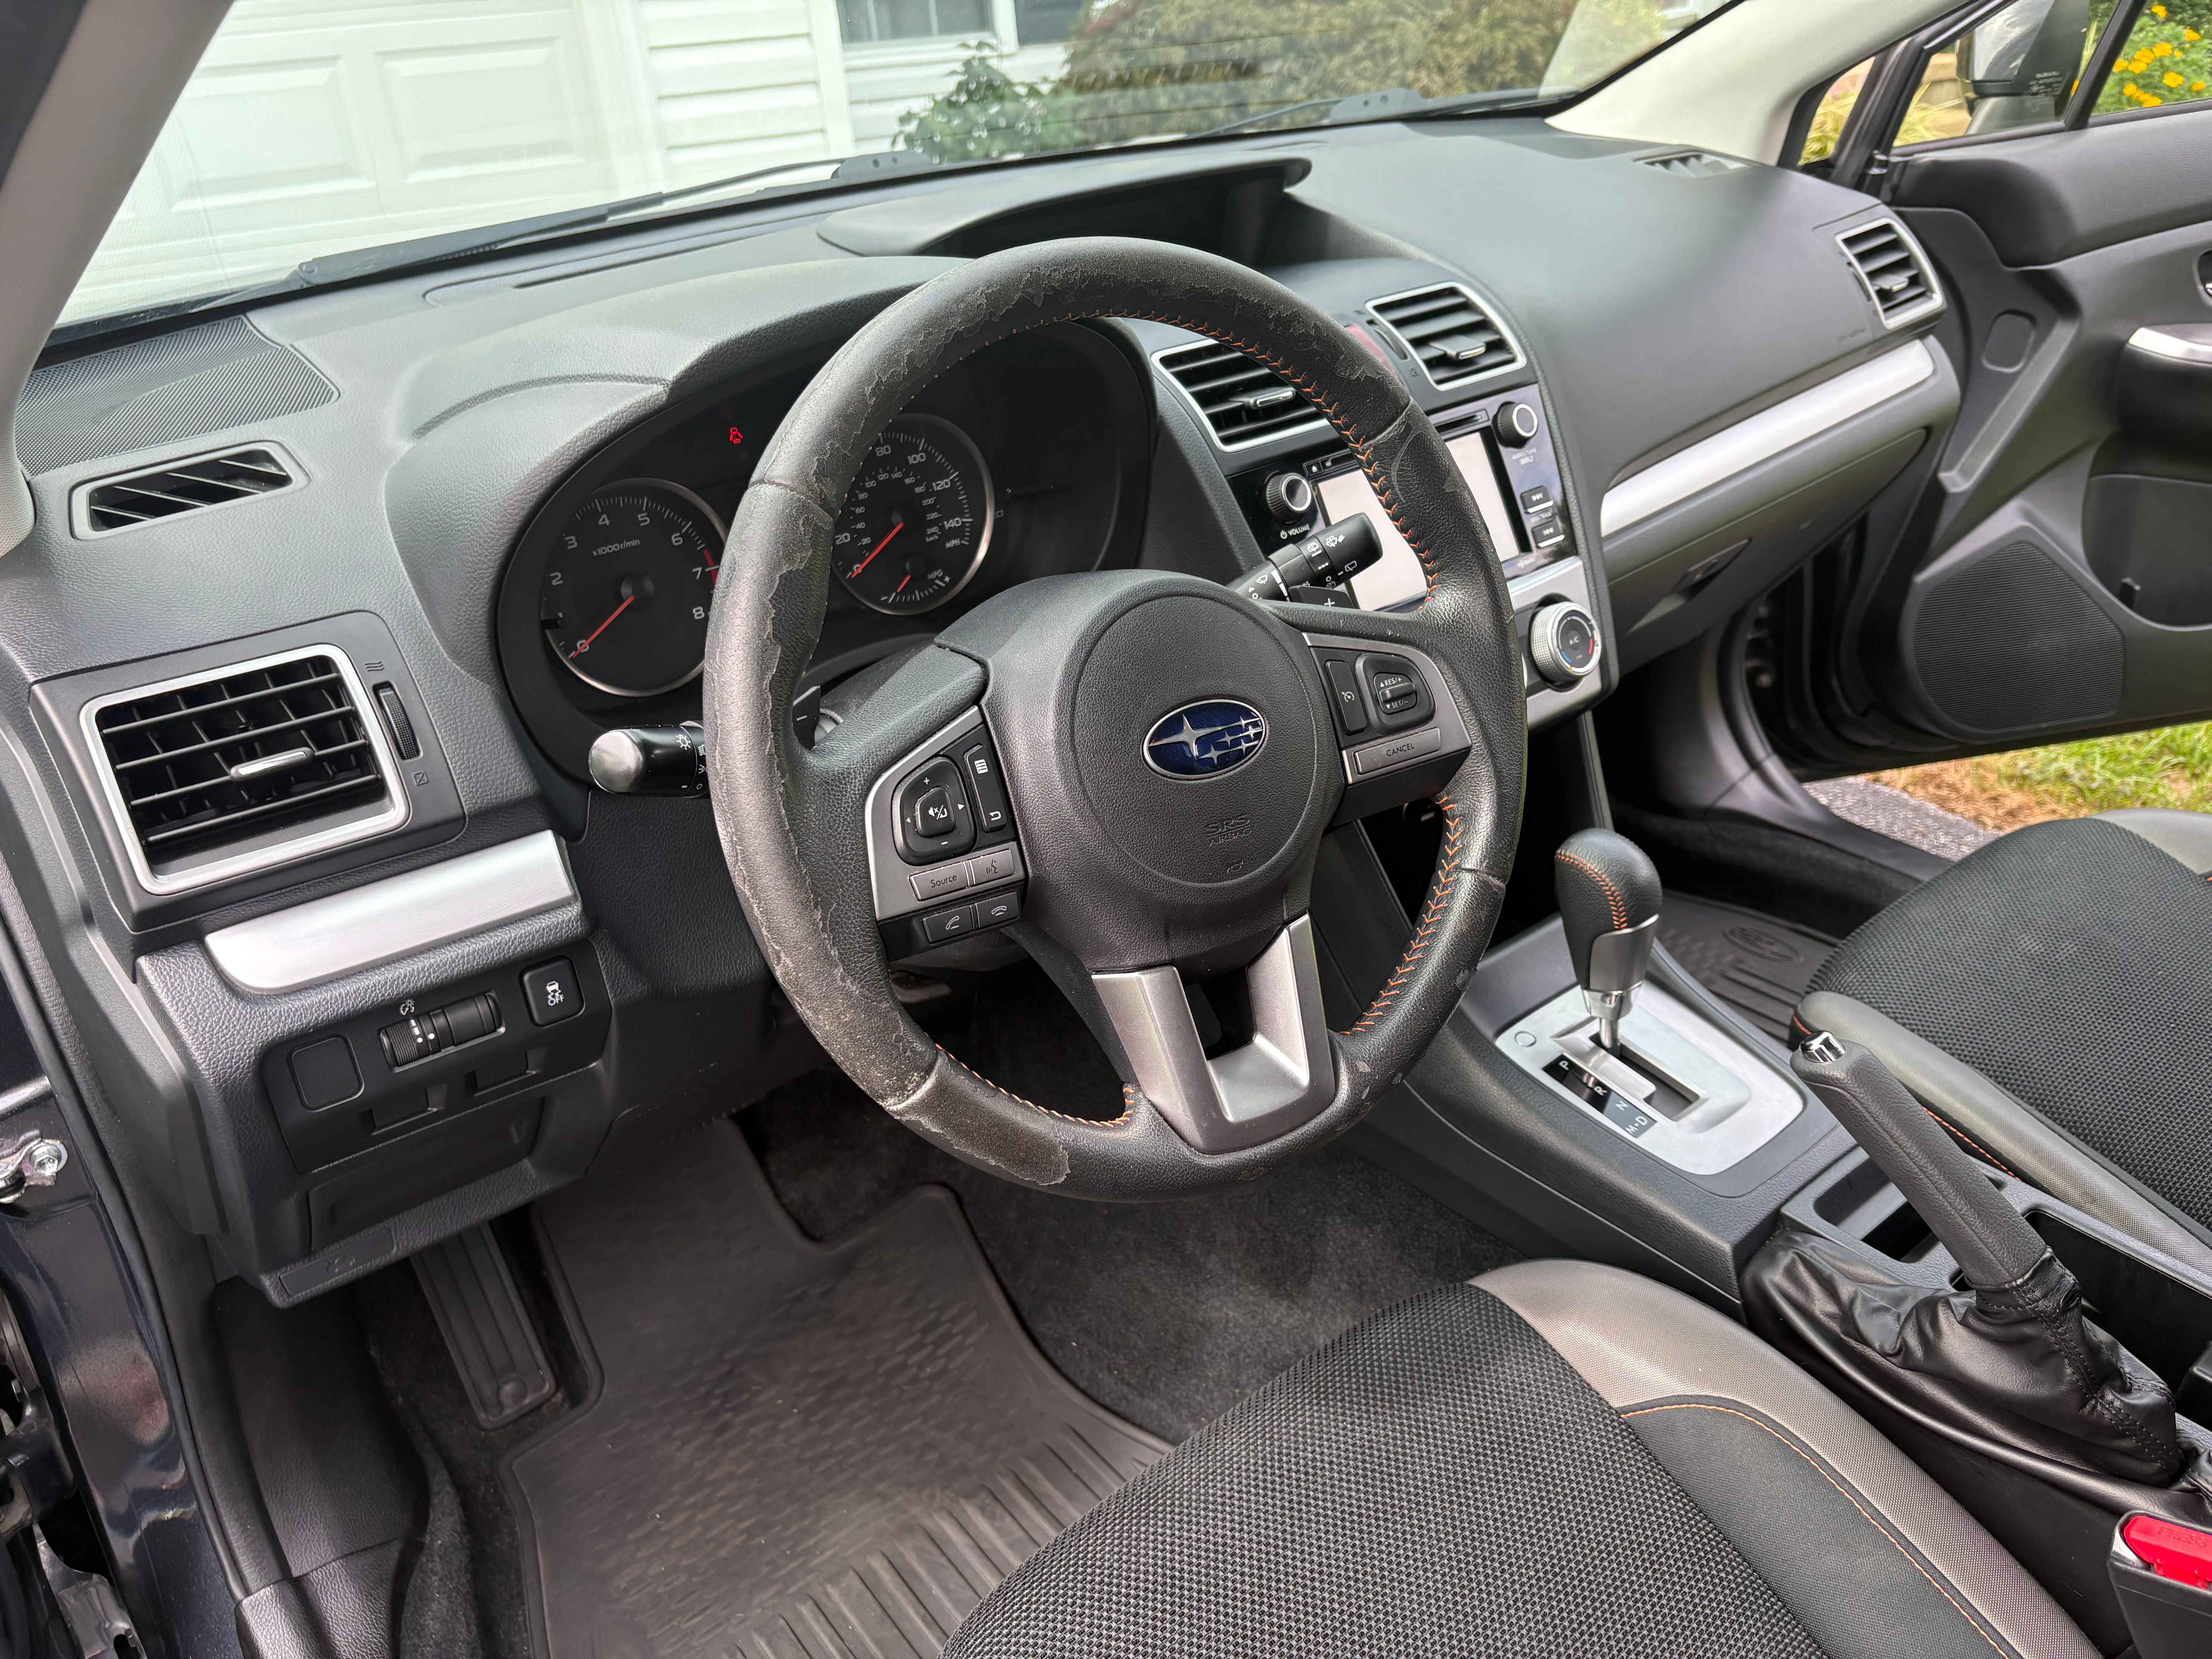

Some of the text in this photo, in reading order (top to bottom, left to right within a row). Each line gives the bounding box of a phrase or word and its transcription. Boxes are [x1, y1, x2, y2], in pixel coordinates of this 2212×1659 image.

[875, 445, 891, 457] 80
[907, 452, 926, 464] 100
[932, 479, 951, 491] 120
[598, 514, 610, 526] 4
[638, 512, 650, 526] 5
[944, 517, 962, 530] 140
[1288, 525, 1310, 536] VOLUME
[565, 535, 577, 549] 3
[671, 532, 683, 546] 6
[835, 532, 851, 545] 20
[945, 539, 960, 549] MPH
[550, 572, 563, 586] 2
[692, 567, 703, 580] 7
[927, 570, 943, 580] MPG
[692, 606, 705, 620] 8
[1386, 743, 1415, 757] CANCEL
[931, 875, 957, 888] Source
[548, 994, 564, 1006] OFF
[1559, 1061, 1570, 1070] P
[1594, 1086, 1607, 1096] R
[1616, 1101, 1629, 1111] N
[2157, 1526, 2208, 1548] PRESS
